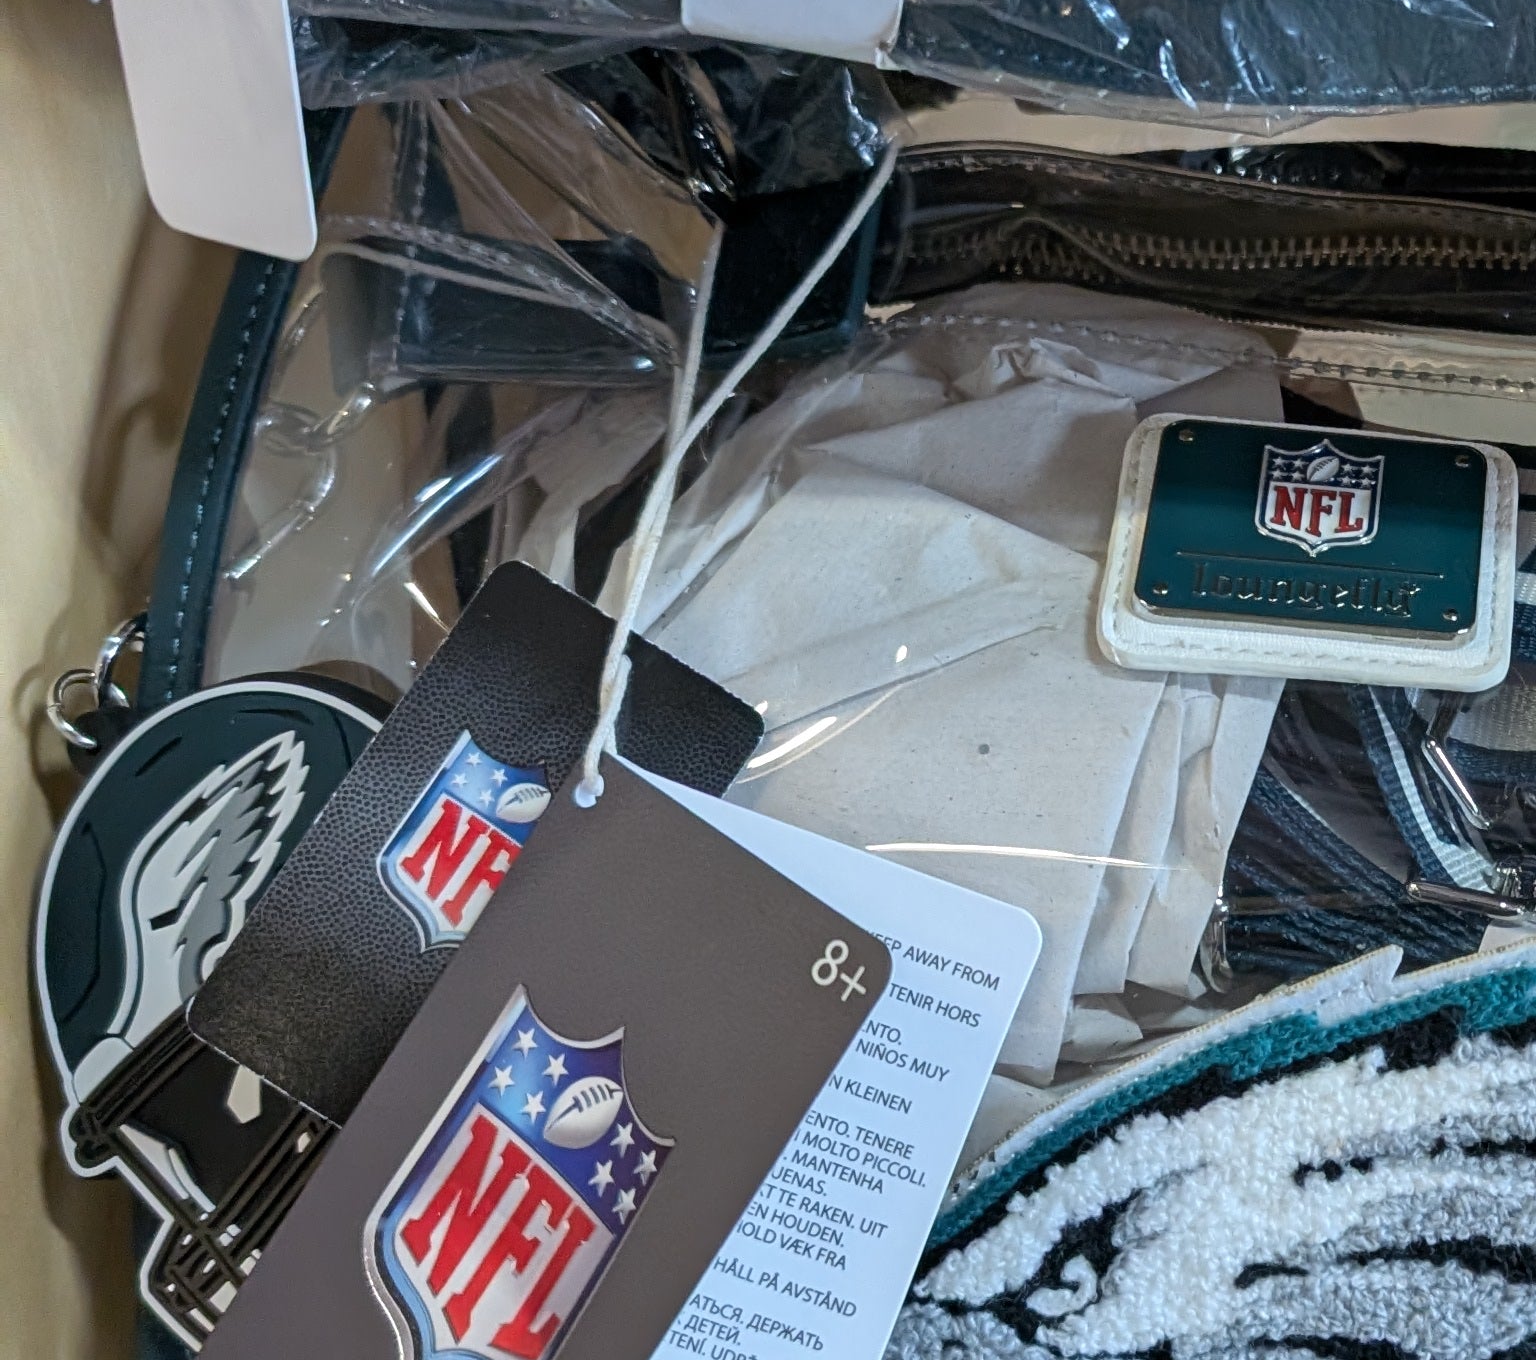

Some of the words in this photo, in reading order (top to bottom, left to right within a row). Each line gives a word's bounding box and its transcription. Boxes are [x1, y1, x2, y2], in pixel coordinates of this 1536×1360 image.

[1270, 486, 1364, 537] NFL
[400, 798, 523, 928] NF
[811, 939, 867, 1002] 8+
[903, 945, 952, 972] AWAY
[951, 962, 1000, 991] FROM
[888, 982, 934, 1011] TENIR
[935, 1000, 982, 1028] HORS
[863, 1020, 902, 1045] NTO.
[855, 1038, 908, 1068] NIÑOS
[909, 1058, 950, 1082] MUY
[844, 1078, 912, 1114] KLEINEN
[802, 1131, 861, 1162] MOLTO
[862, 1152, 926, 1188] PICCOLI.
[855, 1125, 915, 1160] TENERE
[791, 1149, 884, 1195] MANTENHA
[770, 1209, 844, 1248] HOUDEN.
[778, 1188, 798, 1208] TE
[799, 1196, 855, 1229] RAKEN.
[860, 1218, 888, 1239] UIT
[399, 1115, 598, 1360] NFL
[780, 1233, 816, 1258] VÆK
[816, 1247, 846, 1271] FRA
[713, 1256, 754, 1283] HÅLL
[758, 1271, 780, 1291] PÅ
[781, 1281, 857, 1317] AVSTÅND
[684, 1314, 741, 1346] ДЕТЕЙ.
[689, 1293, 744, 1325] АТЬСЯ.
[746, 1313, 824, 1351] ДЕРЖАТЬ
